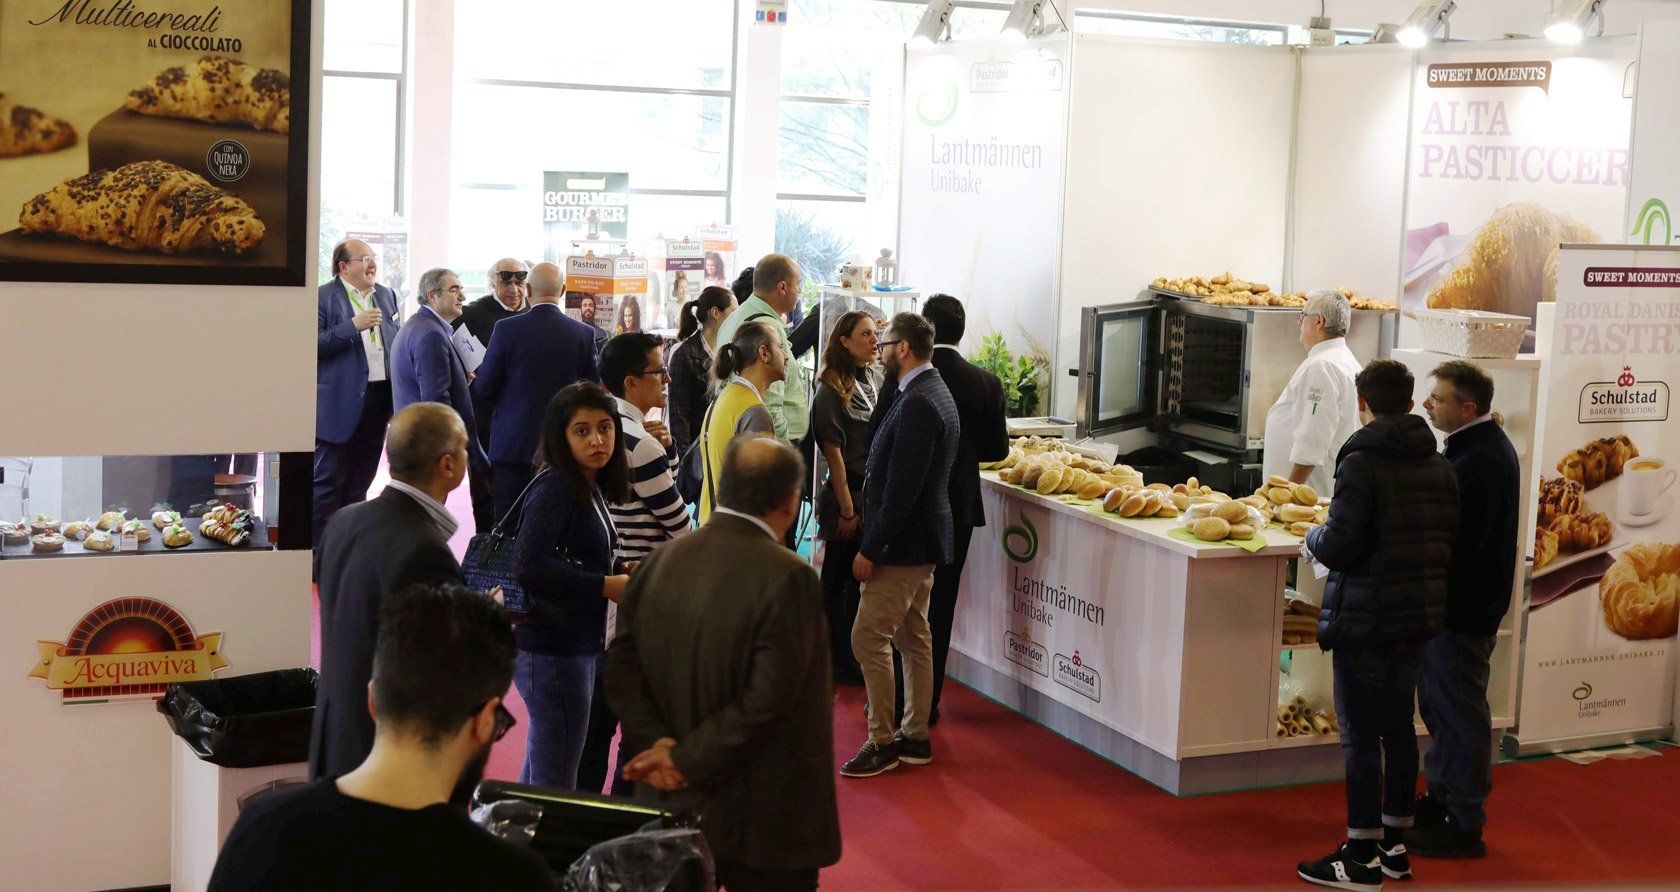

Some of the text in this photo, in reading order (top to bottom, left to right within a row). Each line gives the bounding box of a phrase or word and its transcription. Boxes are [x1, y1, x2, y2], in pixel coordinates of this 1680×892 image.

[28, 0, 222, 32] Multicereali
[147, 34, 242, 53] AL CIOCCOLATO
[1430, 66, 1547, 82] SWEET MOMENTS
[1420, 100, 1512, 136] ALTA
[214, 151, 243, 166] QUINOA
[931, 134, 1042, 168] Lantmännen
[219, 165, 237, 176] NERA
[931, 169, 982, 194] Unibake
[544, 191, 628, 206] GOURM
[572, 260, 608, 270] Pastridor
[619, 262, 645, 270] Schulstad
[1587, 272, 1680, 283] SWEET MOMENTS
[1563, 302, 1624, 319] ROYAL
[1561, 322, 1680, 356] PASTR
[1591, 389, 1657, 405] Schulstad
[1589, 406, 1657, 416] BAKERY SOLUTIONS
[1014, 566, 1105, 626] Lantmännen
[1013, 593, 1054, 628] Unibake
[1009, 637, 1043, 662] Pastridor
[63, 655, 197, 685] Acquaviva
[1059, 660, 1095, 686] Schulstad
[1579, 698, 1627, 711] Lantmännen
